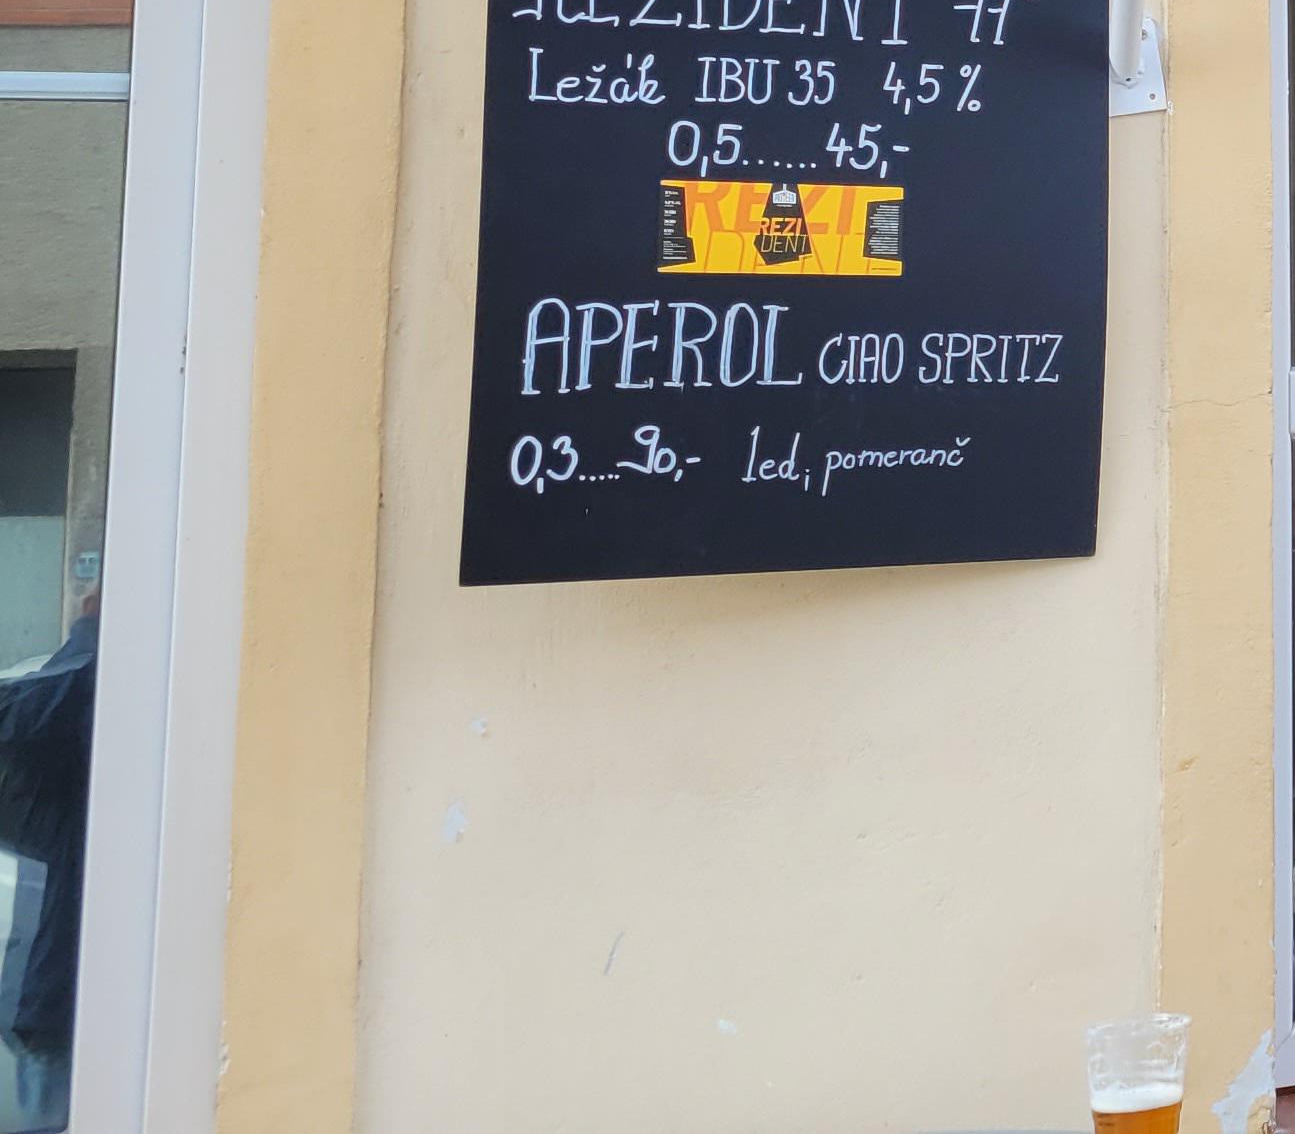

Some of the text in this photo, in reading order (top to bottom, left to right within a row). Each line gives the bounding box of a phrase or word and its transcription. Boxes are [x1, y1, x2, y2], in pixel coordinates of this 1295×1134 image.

[528, 47, 667, 105] Ležák
[695, 56, 780, 105] IBU
[787, 61, 836, 106] 35
[760, 234, 809, 253] DENT
[521, 298, 1064, 395] APEROL CIAO SPRITZ
[822, 436, 971, 497] pomeranč
